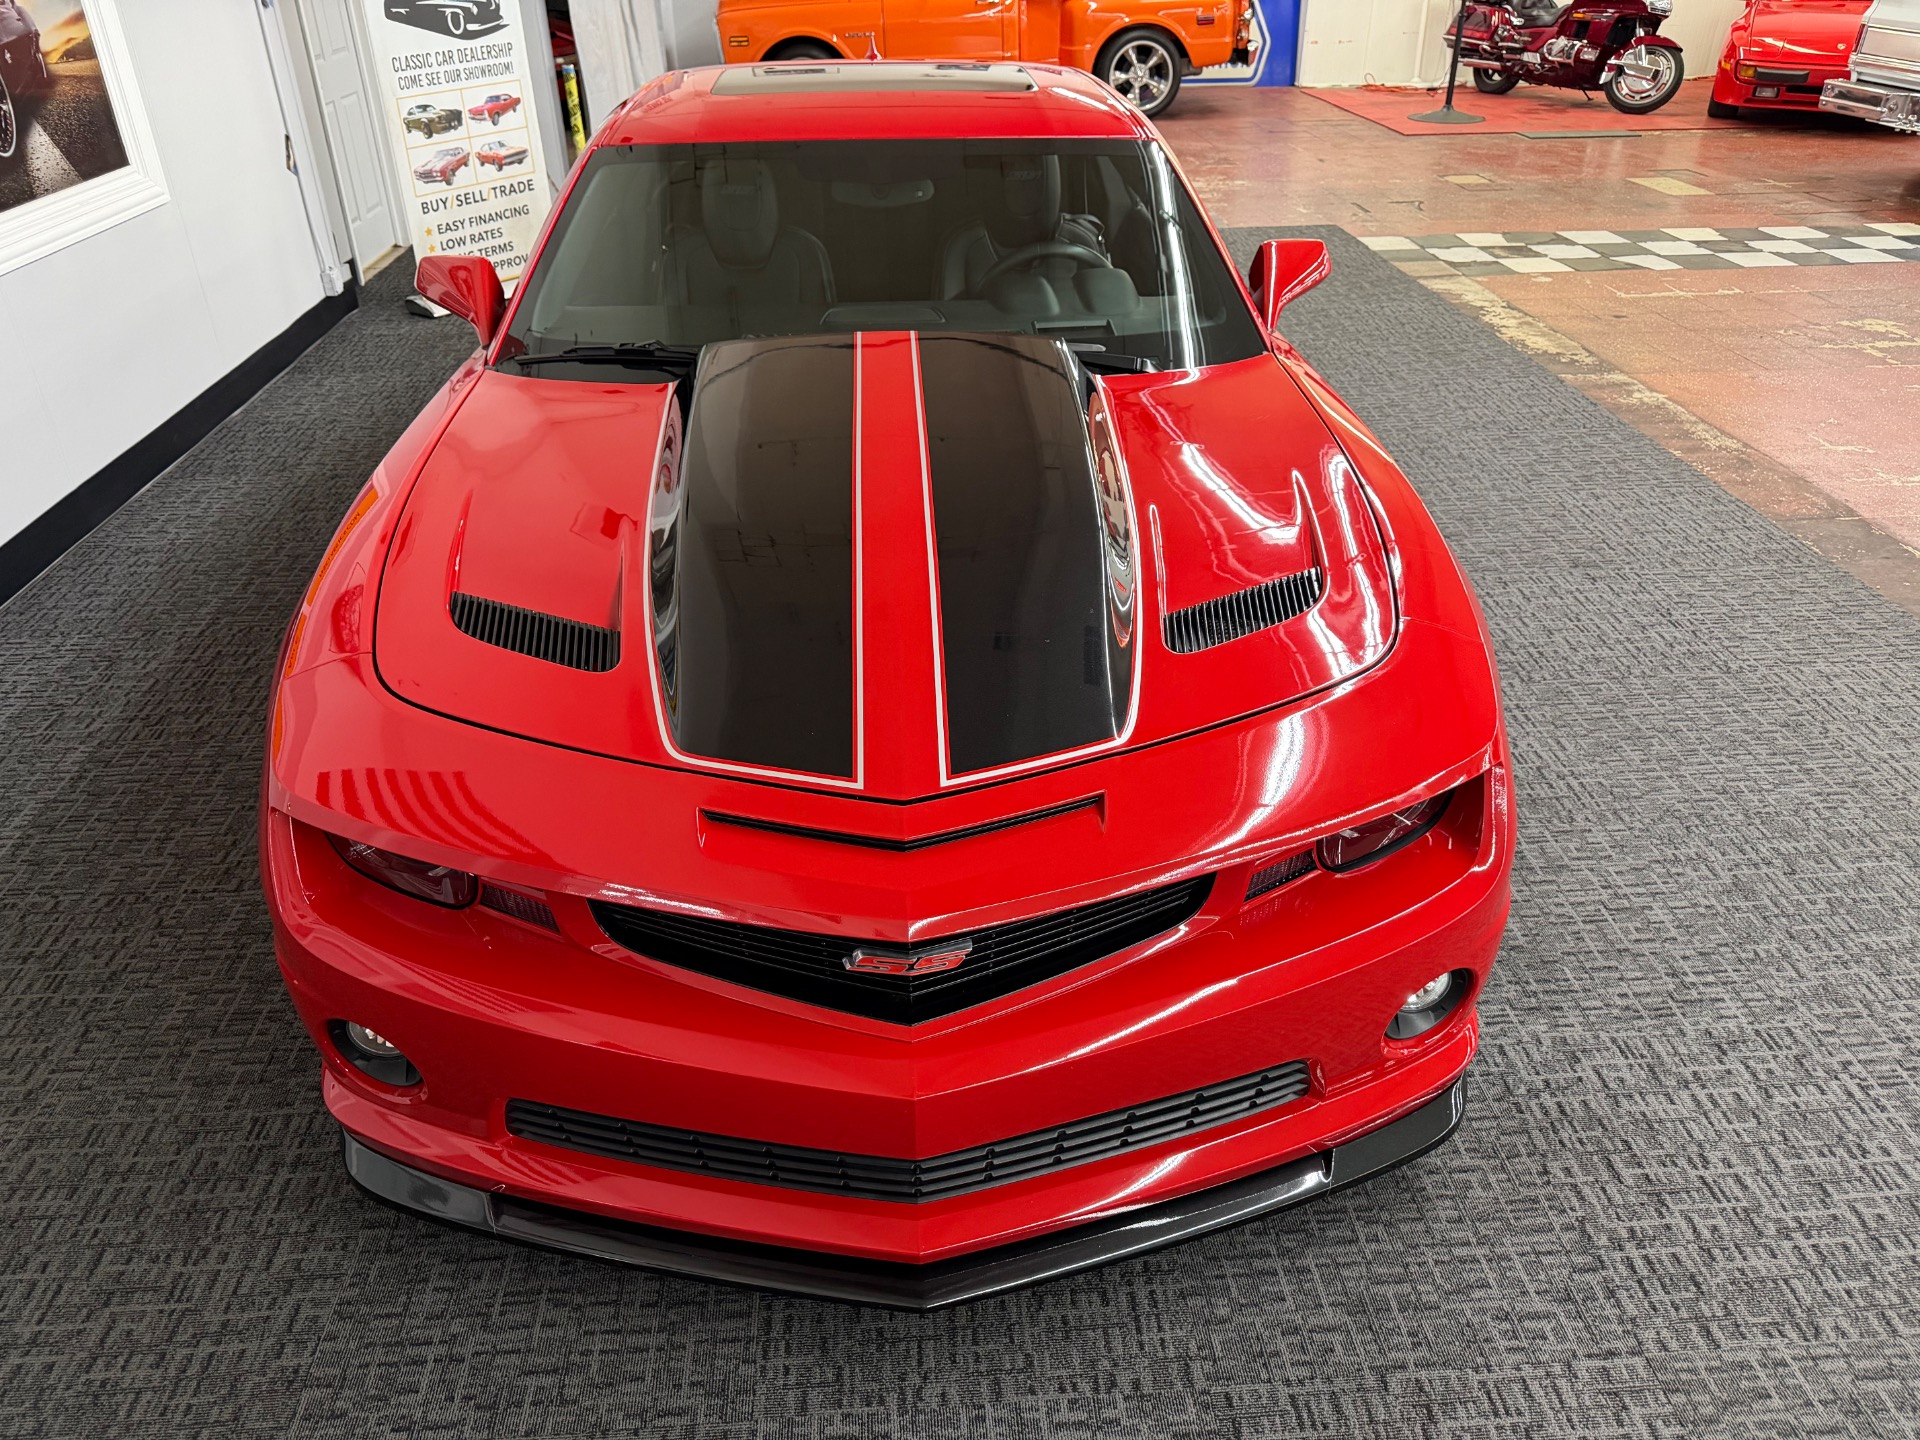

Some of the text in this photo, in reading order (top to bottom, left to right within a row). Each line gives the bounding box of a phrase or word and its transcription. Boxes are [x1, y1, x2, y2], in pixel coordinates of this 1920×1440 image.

[391, 42, 513, 73] CLASSIC CAR DEALERSHIP
[397, 61, 515, 91] COME SEE OUR SHOWROOM!
[437, 204, 530, 235] EASY FINANCING
[440, 227, 503, 251] LOW RATES
[477, 241, 514, 258] TERMS
[493, 253, 529, 270] PPROV
[842, 942, 972, 976] SS
